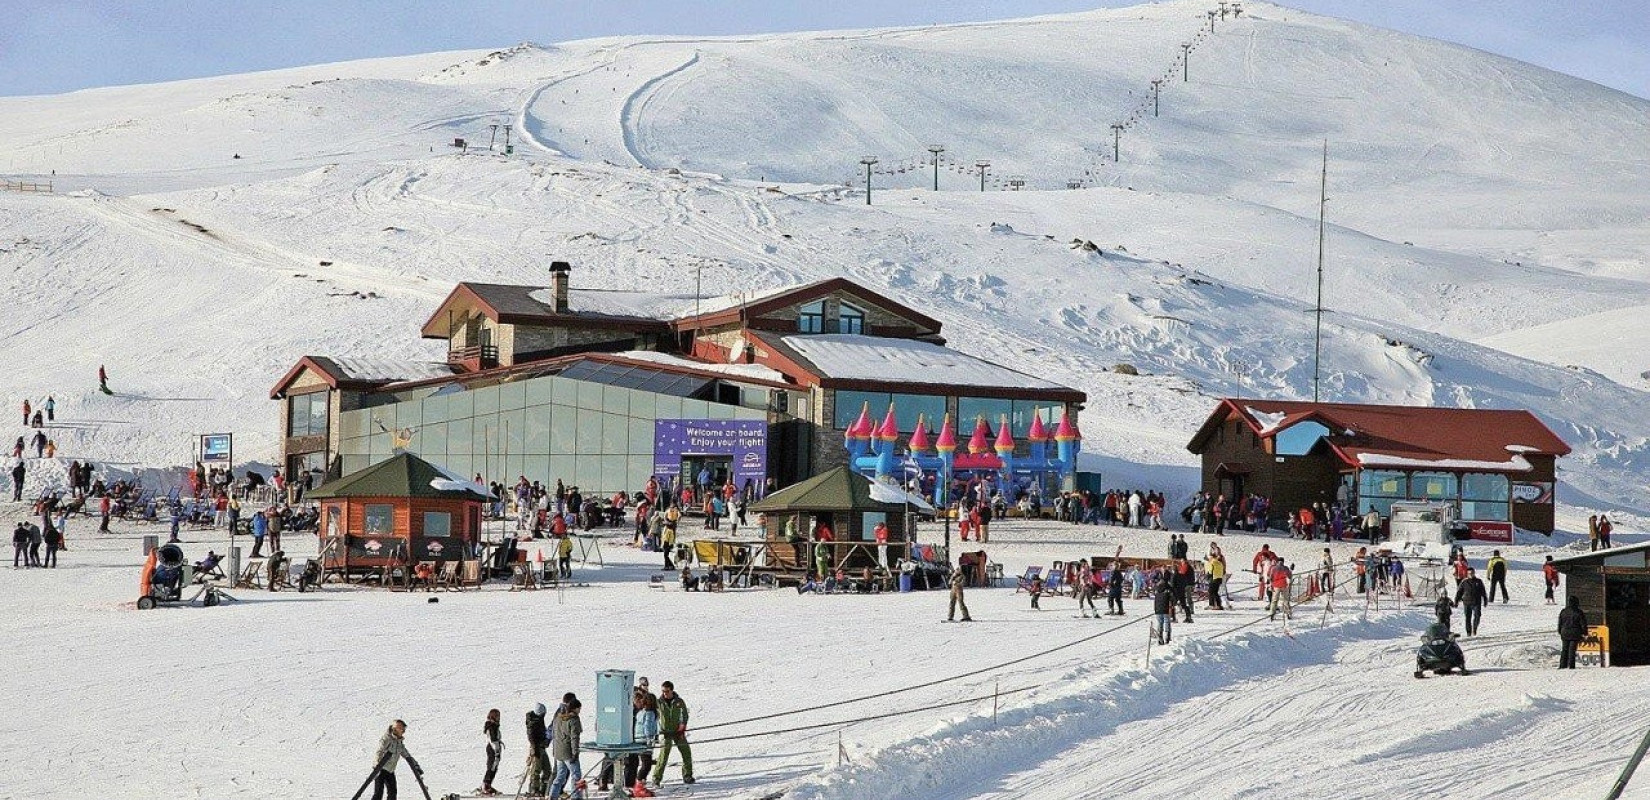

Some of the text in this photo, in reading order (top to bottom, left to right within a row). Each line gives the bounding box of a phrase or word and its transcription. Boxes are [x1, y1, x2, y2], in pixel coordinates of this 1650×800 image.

[686, 427, 723, 437] Welcome
[738, 428, 764, 437] board.
[691, 437, 764, 448] Enjoy your flight!
